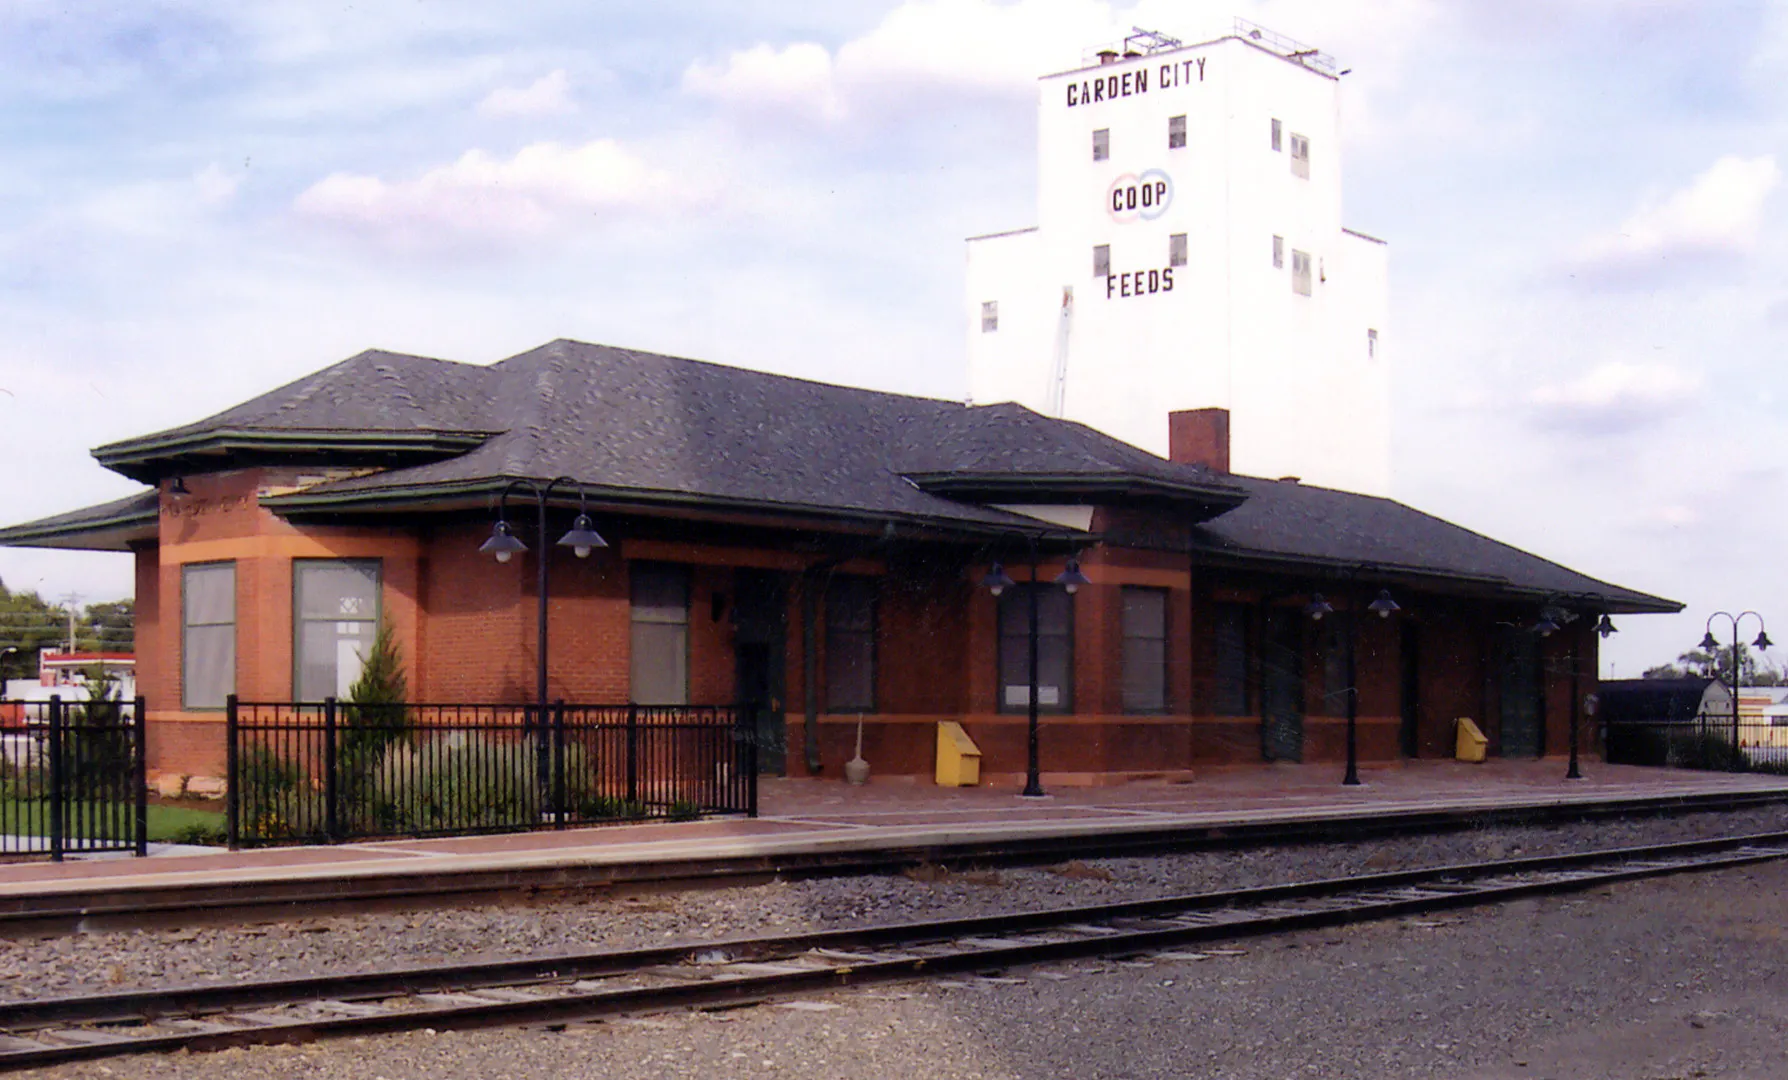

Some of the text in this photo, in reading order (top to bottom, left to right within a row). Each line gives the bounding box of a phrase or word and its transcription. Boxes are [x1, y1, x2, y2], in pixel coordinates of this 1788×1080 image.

[1066, 57, 1206, 107] GARDEN CITY
[1112, 181, 1166, 212] COOP
[1107, 267, 1174, 300] FEEDS
